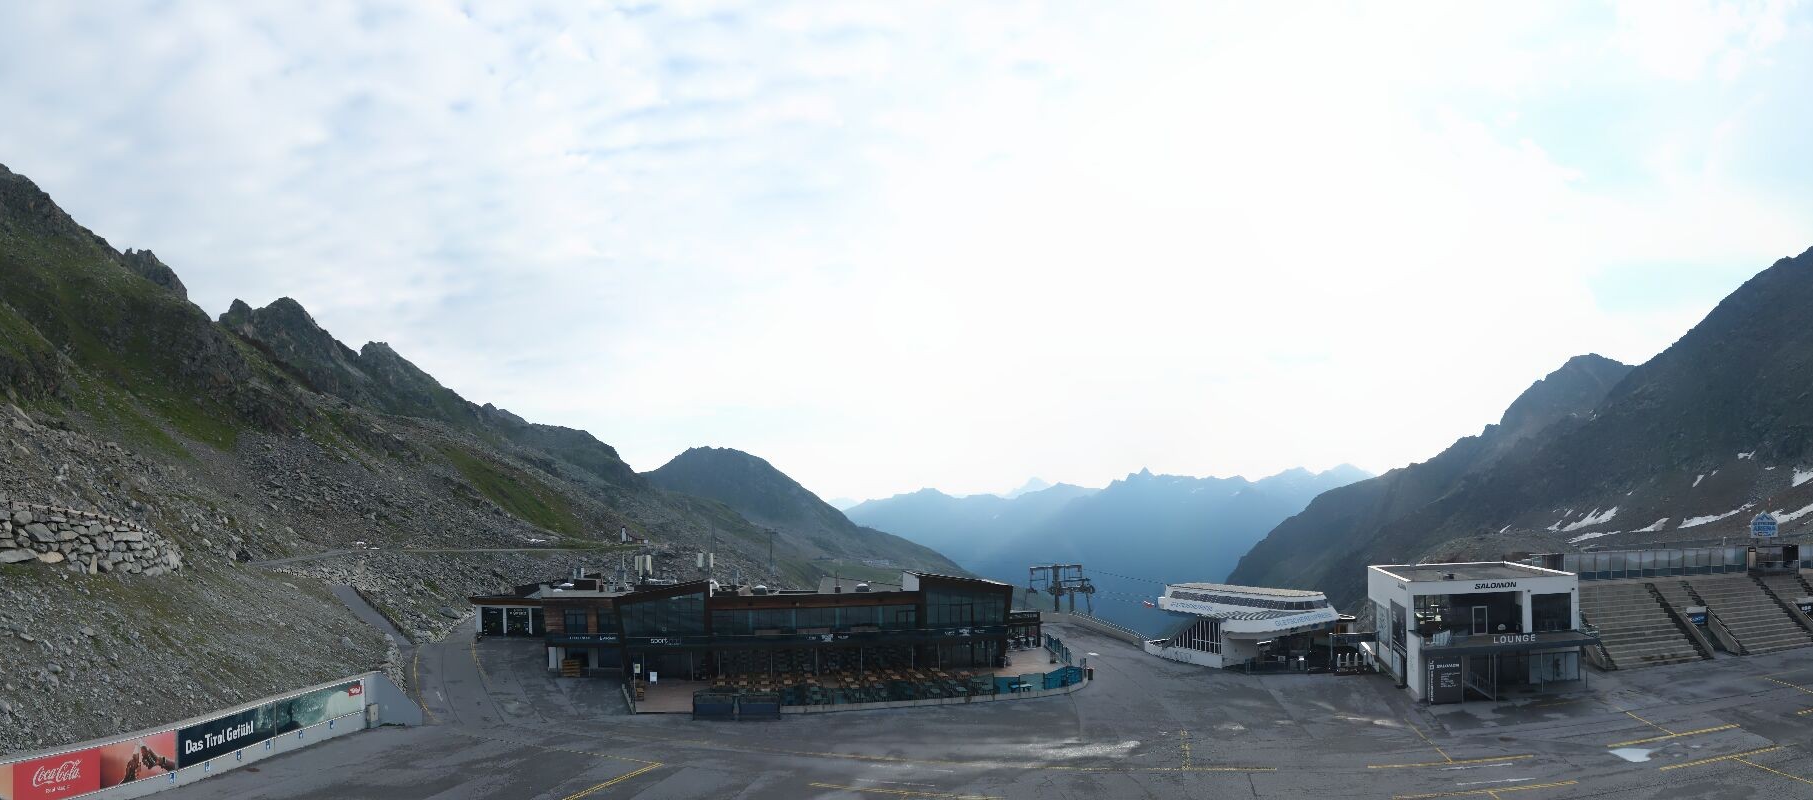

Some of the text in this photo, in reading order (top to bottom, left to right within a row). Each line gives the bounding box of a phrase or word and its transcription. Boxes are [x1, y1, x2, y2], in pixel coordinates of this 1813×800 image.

[1475, 582, 1517, 590] SALOMON
[1493, 634, 1536, 644] LOUNGE
[185, 720, 254, 755] Das Tirol Gefühl
[32, 760, 82, 787] Coca-Cola
